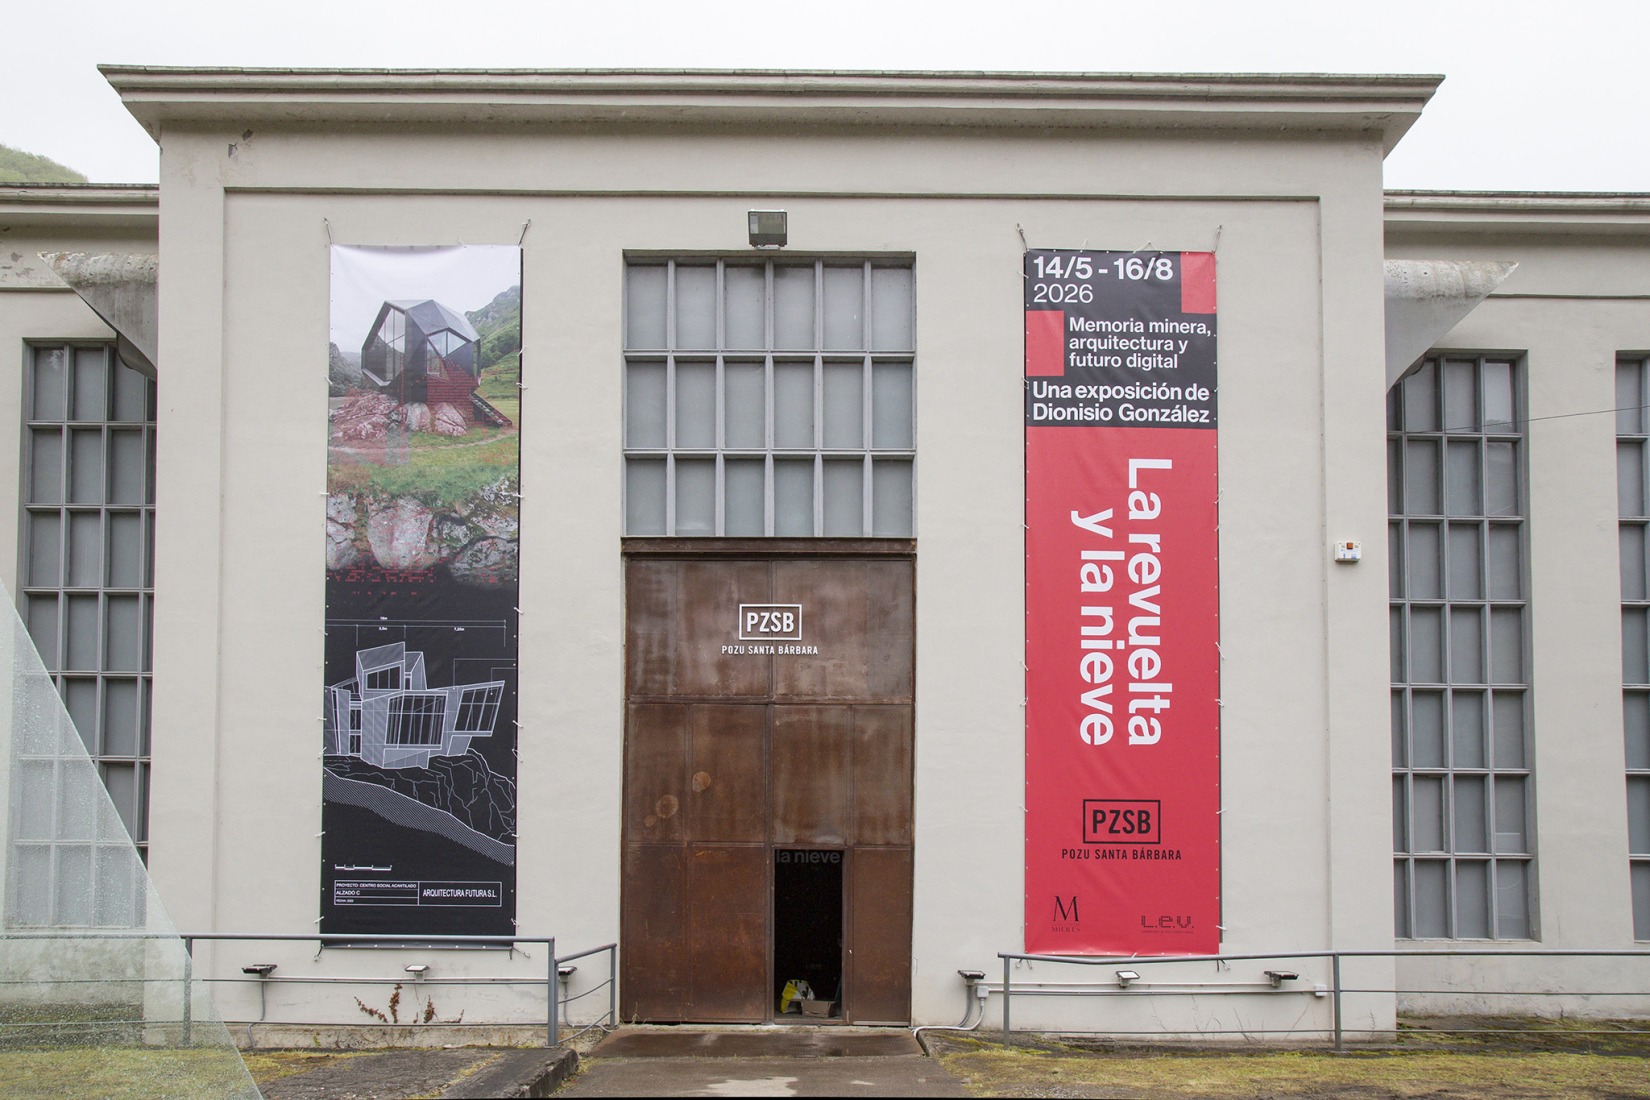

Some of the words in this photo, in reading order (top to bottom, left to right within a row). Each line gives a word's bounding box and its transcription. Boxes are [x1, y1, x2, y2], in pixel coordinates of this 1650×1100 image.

[1034, 256, 1092, 279] 14/5
[1114, 258, 1173, 280] 16/8
[1034, 284, 1093, 303] 2026
[1070, 317, 1143, 332] Memoria
[1150, 319, 1210, 336] minera,
[1069, 335, 1174, 354] arquitectura
[1178, 339, 1189, 355] y
[1069, 352, 1122, 368] futuro
[1126, 353, 1178, 372] digital
[1034, 381, 1071, 398] Una
[1075, 382, 1182, 402] exposición
[1185, 383, 1209, 401] de
[1033, 403, 1113, 421] Dionisio
[1119, 404, 1209, 422] González
[1128, 458, 1173, 521] La
[1070, 507, 1113, 539] y
[1079, 550, 1126, 593] la
[747, 612, 794, 632] PZSB
[722, 646, 744, 654] POZU
[748, 646, 774, 654] SANTA
[779, 644, 818, 654] BÁRBARA
[1127, 533, 1173, 746] revuelta
[1079, 606, 1125, 746] nieve
[1093, 810, 1150, 834] PZSB
[776, 850, 790, 863] la
[794, 850, 840, 864] nieve
[1062, 849, 1089, 859] POZU
[1095, 849, 1127, 859] SANTA
[1133, 848, 1181, 859] BÁRBARA
[422, 889, 465, 898] ARQUITECTURA
[465, 889, 487, 898] FUTURA
